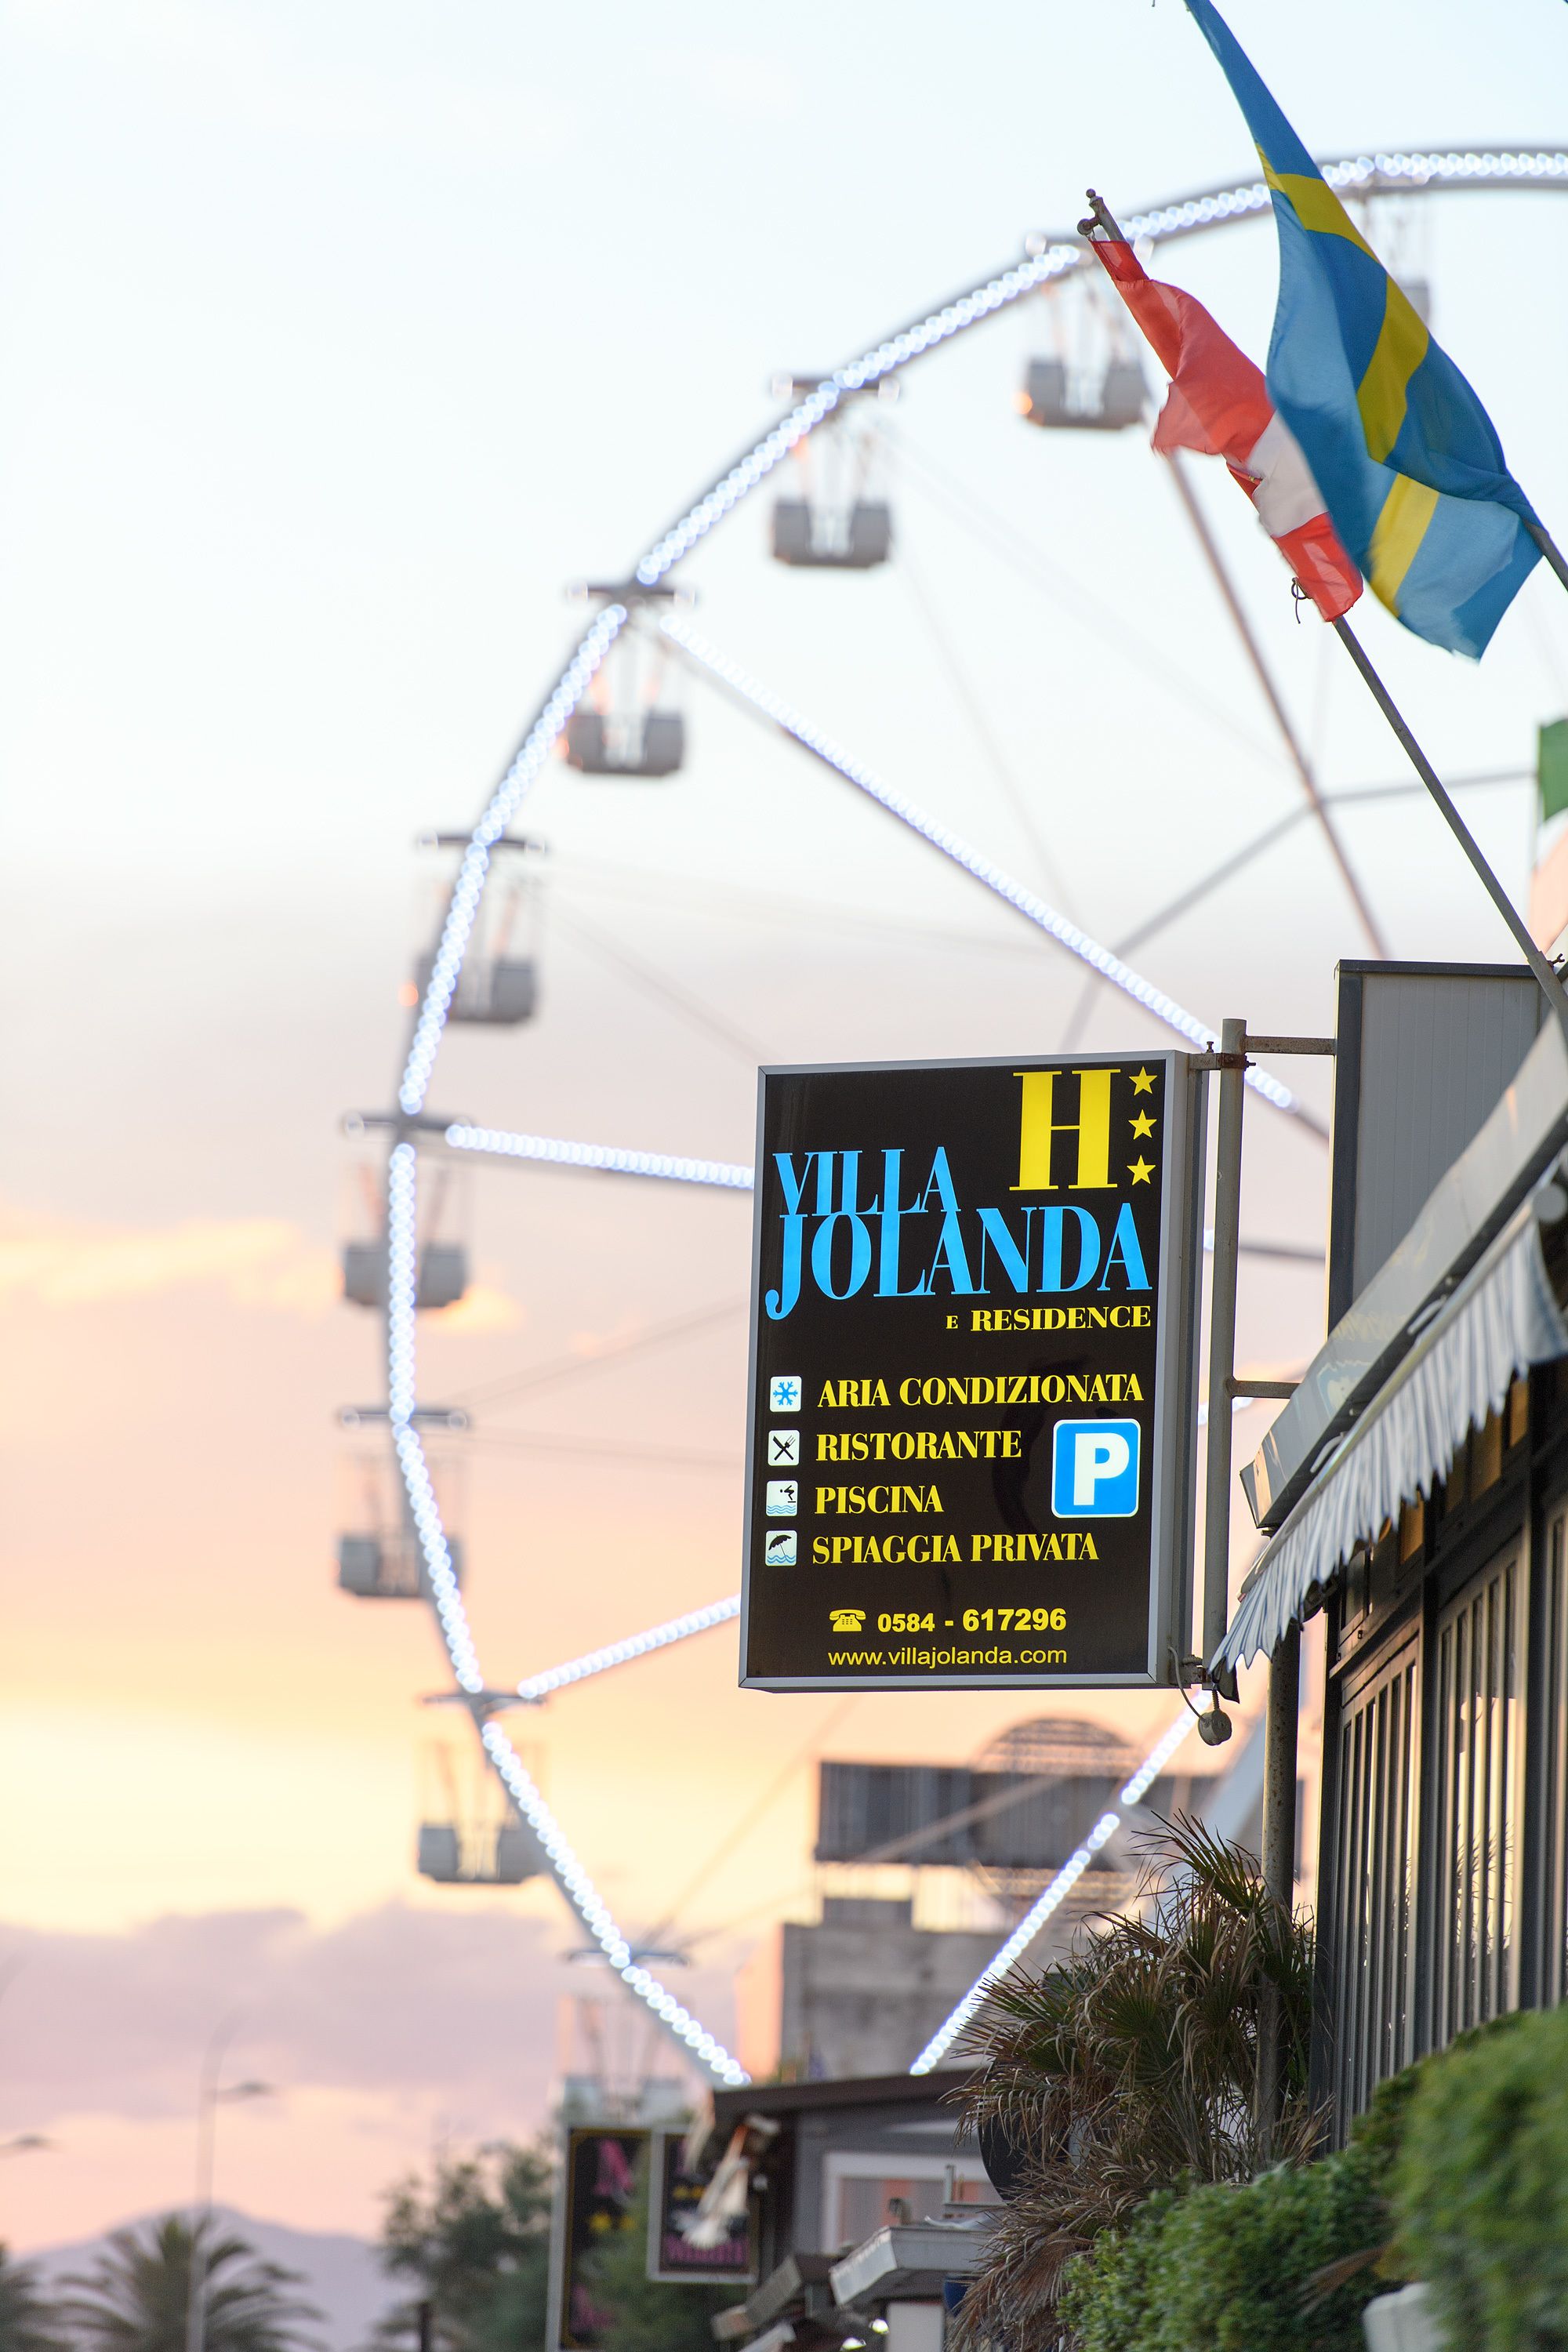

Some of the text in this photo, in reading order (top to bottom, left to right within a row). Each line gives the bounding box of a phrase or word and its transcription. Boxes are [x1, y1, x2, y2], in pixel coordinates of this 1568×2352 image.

[1010, 1069, 1121, 1191] H
[772, 1146, 961, 1216] VILLA
[765, 1203, 1152, 1320] JOLANDA
[946, 1306, 1151, 1331] E RESIDENCE
[818, 1374, 1144, 1407] ARIA CONDIZIONATA
[816, 1431, 1021, 1461] RISTORANTE
[1074, 1433, 1129, 1505] P
[815, 1486, 944, 1514] PISCINA
[813, 1533, 1098, 1564] SPIAGGIA PRIVATA
[877, 1613, 935, 1632] 0584
[963, 1608, 1066, 1632] 617296
[828, 1646, 1067, 1668] www.villajolanda.com
